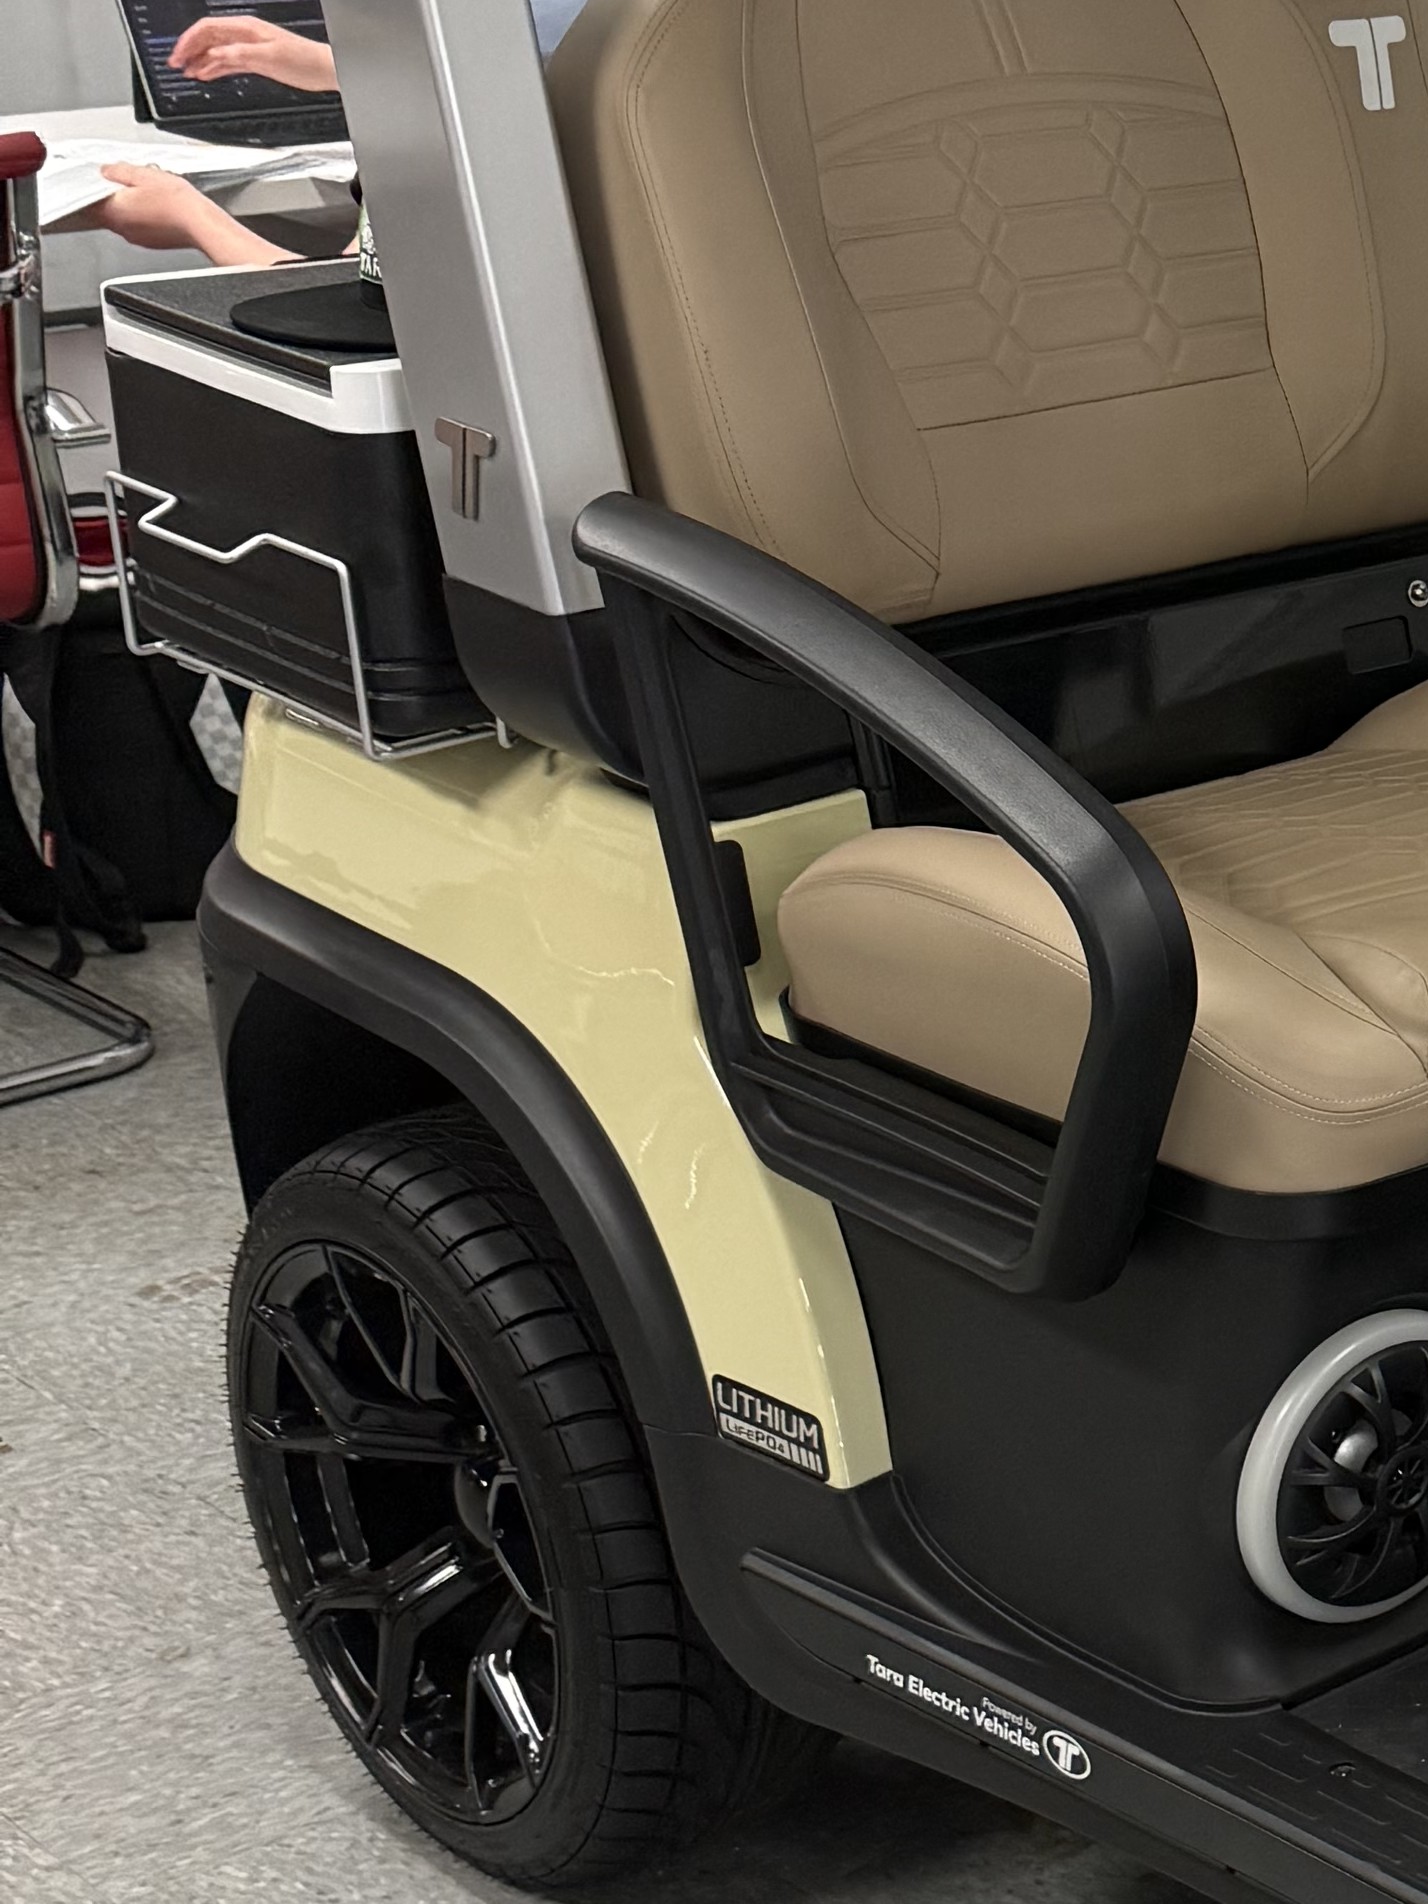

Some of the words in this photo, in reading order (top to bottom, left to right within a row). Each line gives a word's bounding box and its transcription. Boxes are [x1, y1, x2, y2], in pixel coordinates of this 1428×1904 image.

[716, 1382, 819, 1449] LITHIUM
[866, 1653, 904, 1688] Tara
[908, 1674, 970, 1722] Electric
[972, 1706, 1041, 1757] Vehicles
[981, 1696, 1023, 1727] Powered
[1024, 1716, 1038, 1735] by
